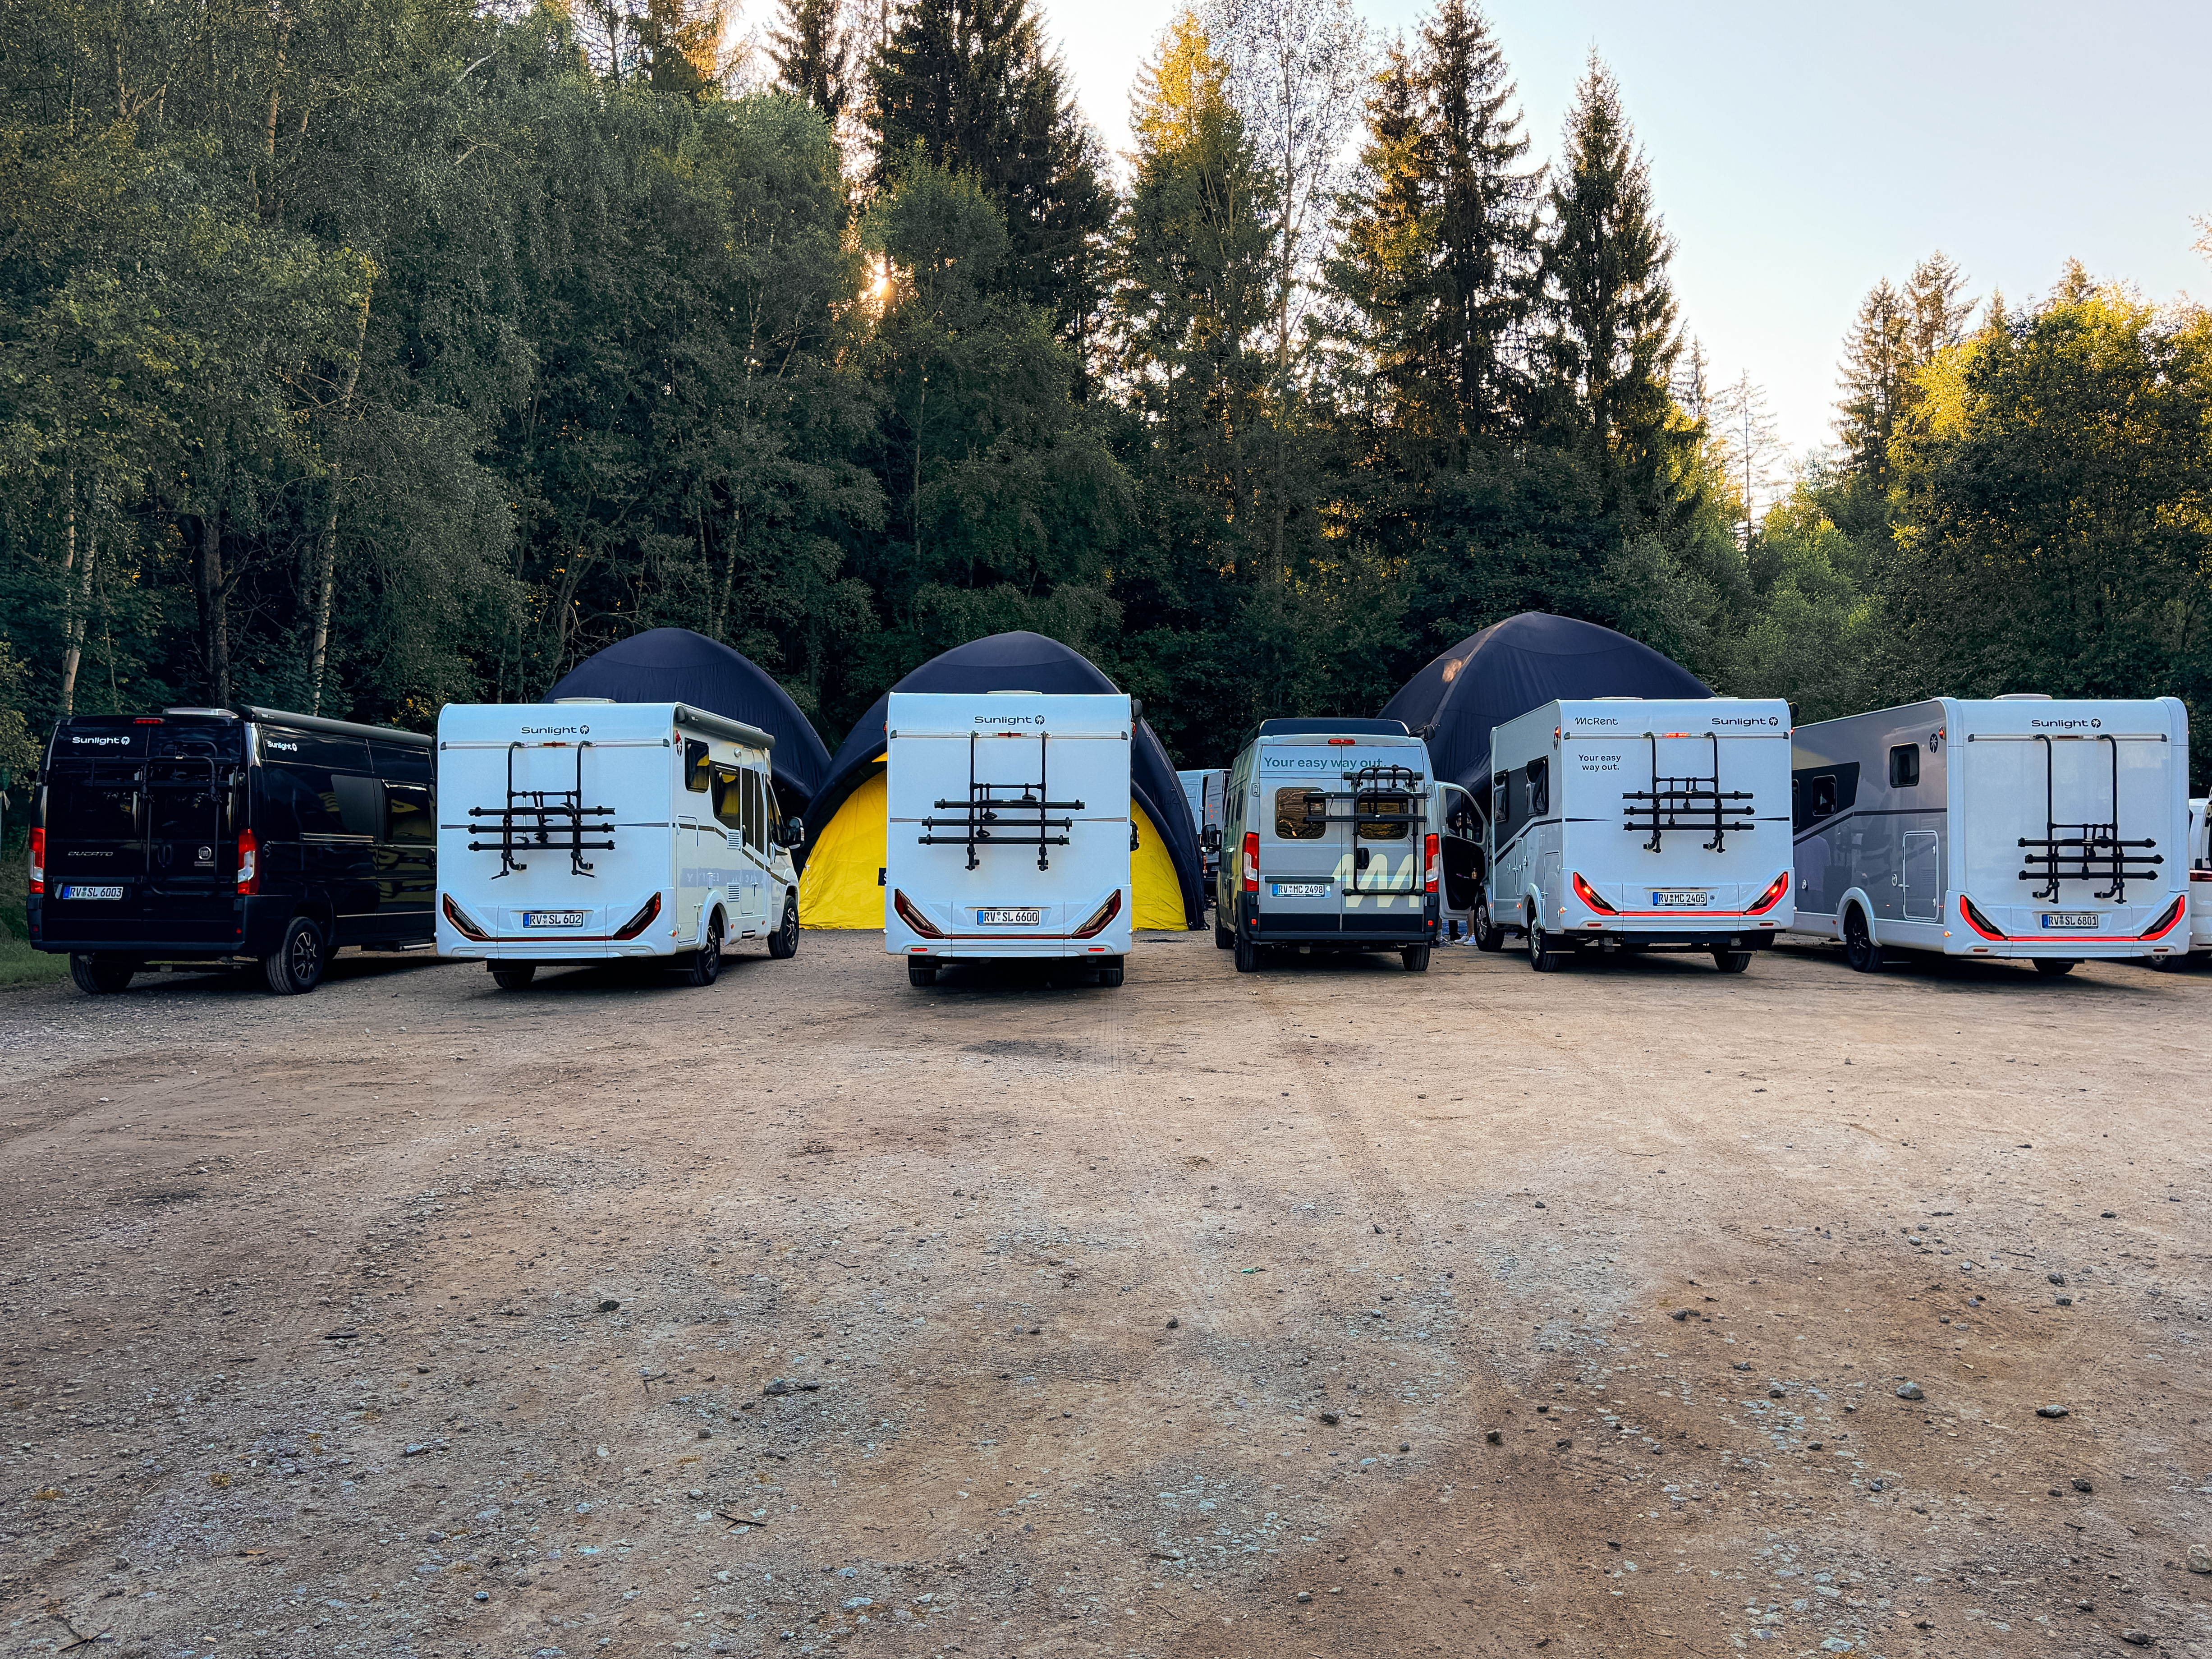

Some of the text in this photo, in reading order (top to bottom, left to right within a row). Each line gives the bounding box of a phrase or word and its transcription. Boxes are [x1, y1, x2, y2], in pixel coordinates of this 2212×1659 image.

[974, 716, 1032, 725] Sunlight
[1574, 717, 1618, 725] McRent
[1712, 718, 1766, 726] Sunlight
[2031, 720, 2088, 729] Sunlight
[521, 726, 577, 735] Sunlight
[72, 737, 119, 745] Sunlight
[267, 741, 292, 750] Sunlight
[1264, 757, 1294, 767] Your
[1297, 759, 1327, 770] easy
[1330, 759, 1357, 770] way
[70, 887, 122, 897] RV SL 6003
[1279, 885, 1323, 893] RV MC 2498
[1659, 894, 1705, 902] RV MC 2405
[530, 915, 581, 924] RV SL 602
[984, 912, 1037, 922] RV SL 6600
[2049, 916, 2097, 925] RV SL 6801
